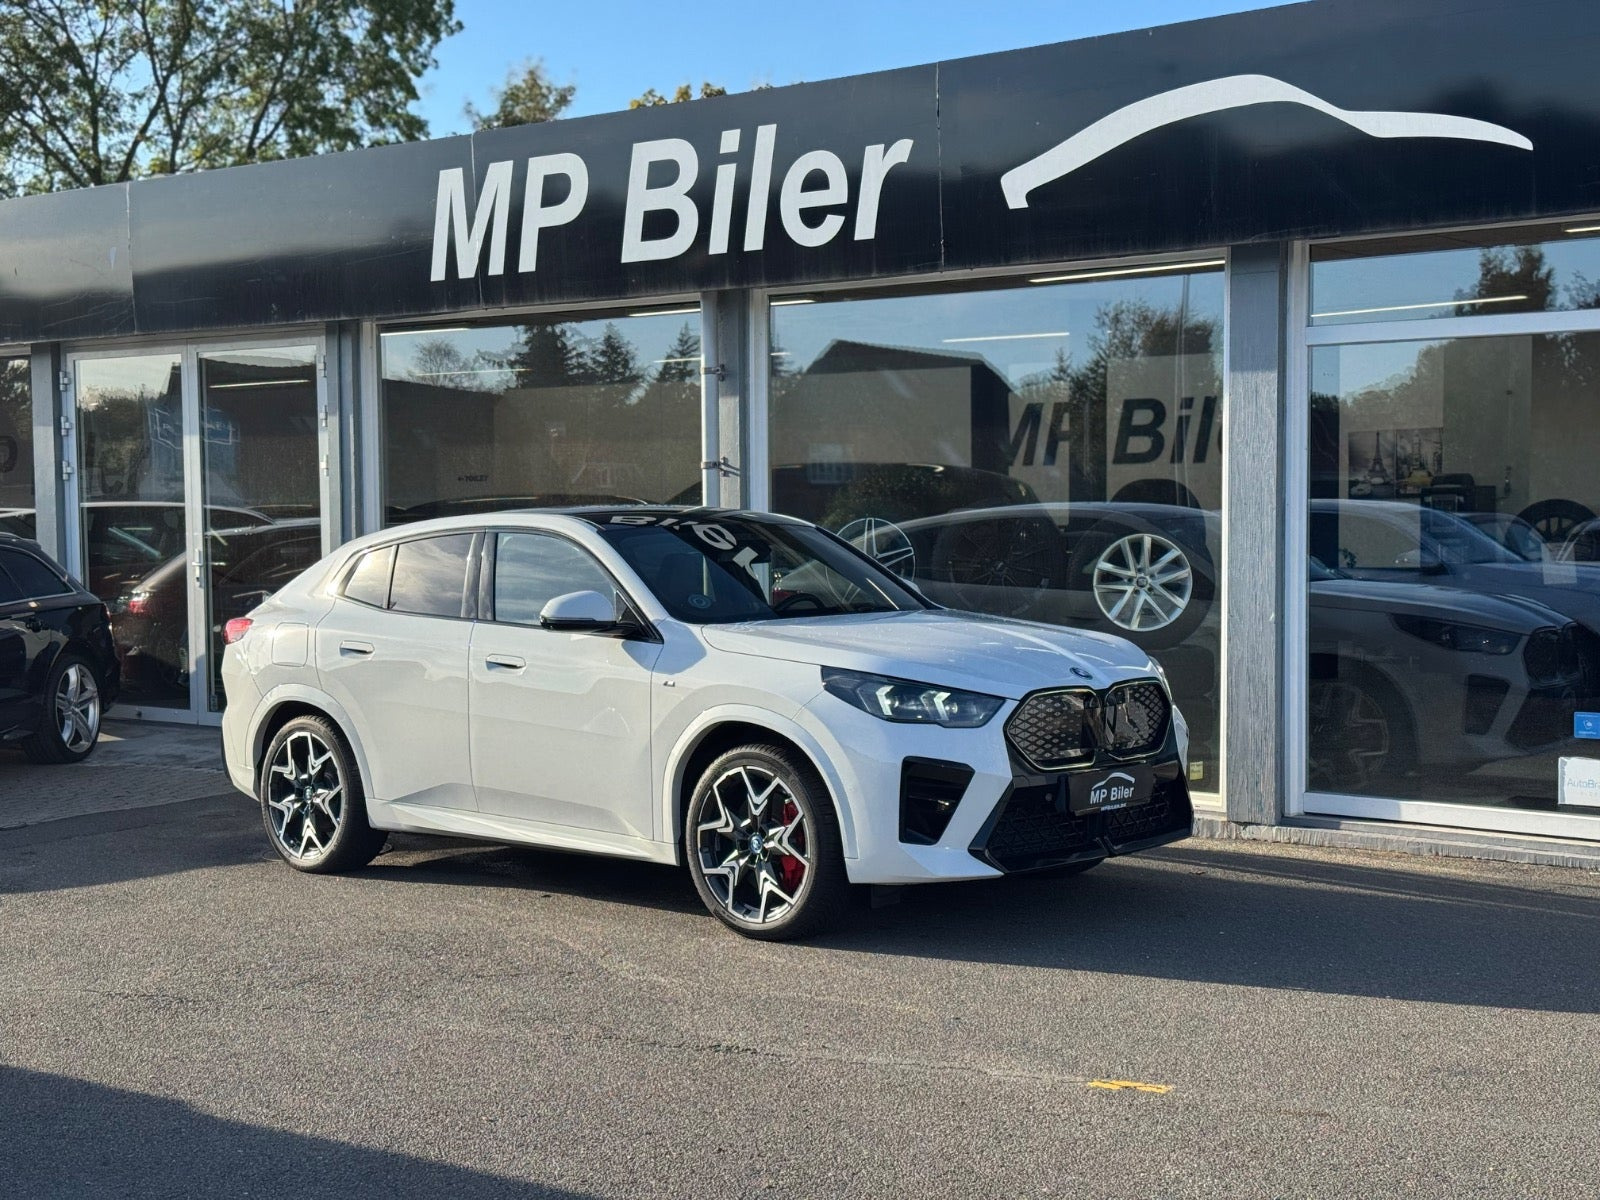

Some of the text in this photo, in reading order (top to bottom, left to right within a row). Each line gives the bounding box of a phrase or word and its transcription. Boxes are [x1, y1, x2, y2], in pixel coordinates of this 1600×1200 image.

[430, 123, 914, 282] MP Biler
[1112, 396, 1223, 465] Bil
[1090, 785, 1134, 804] MP Biler
